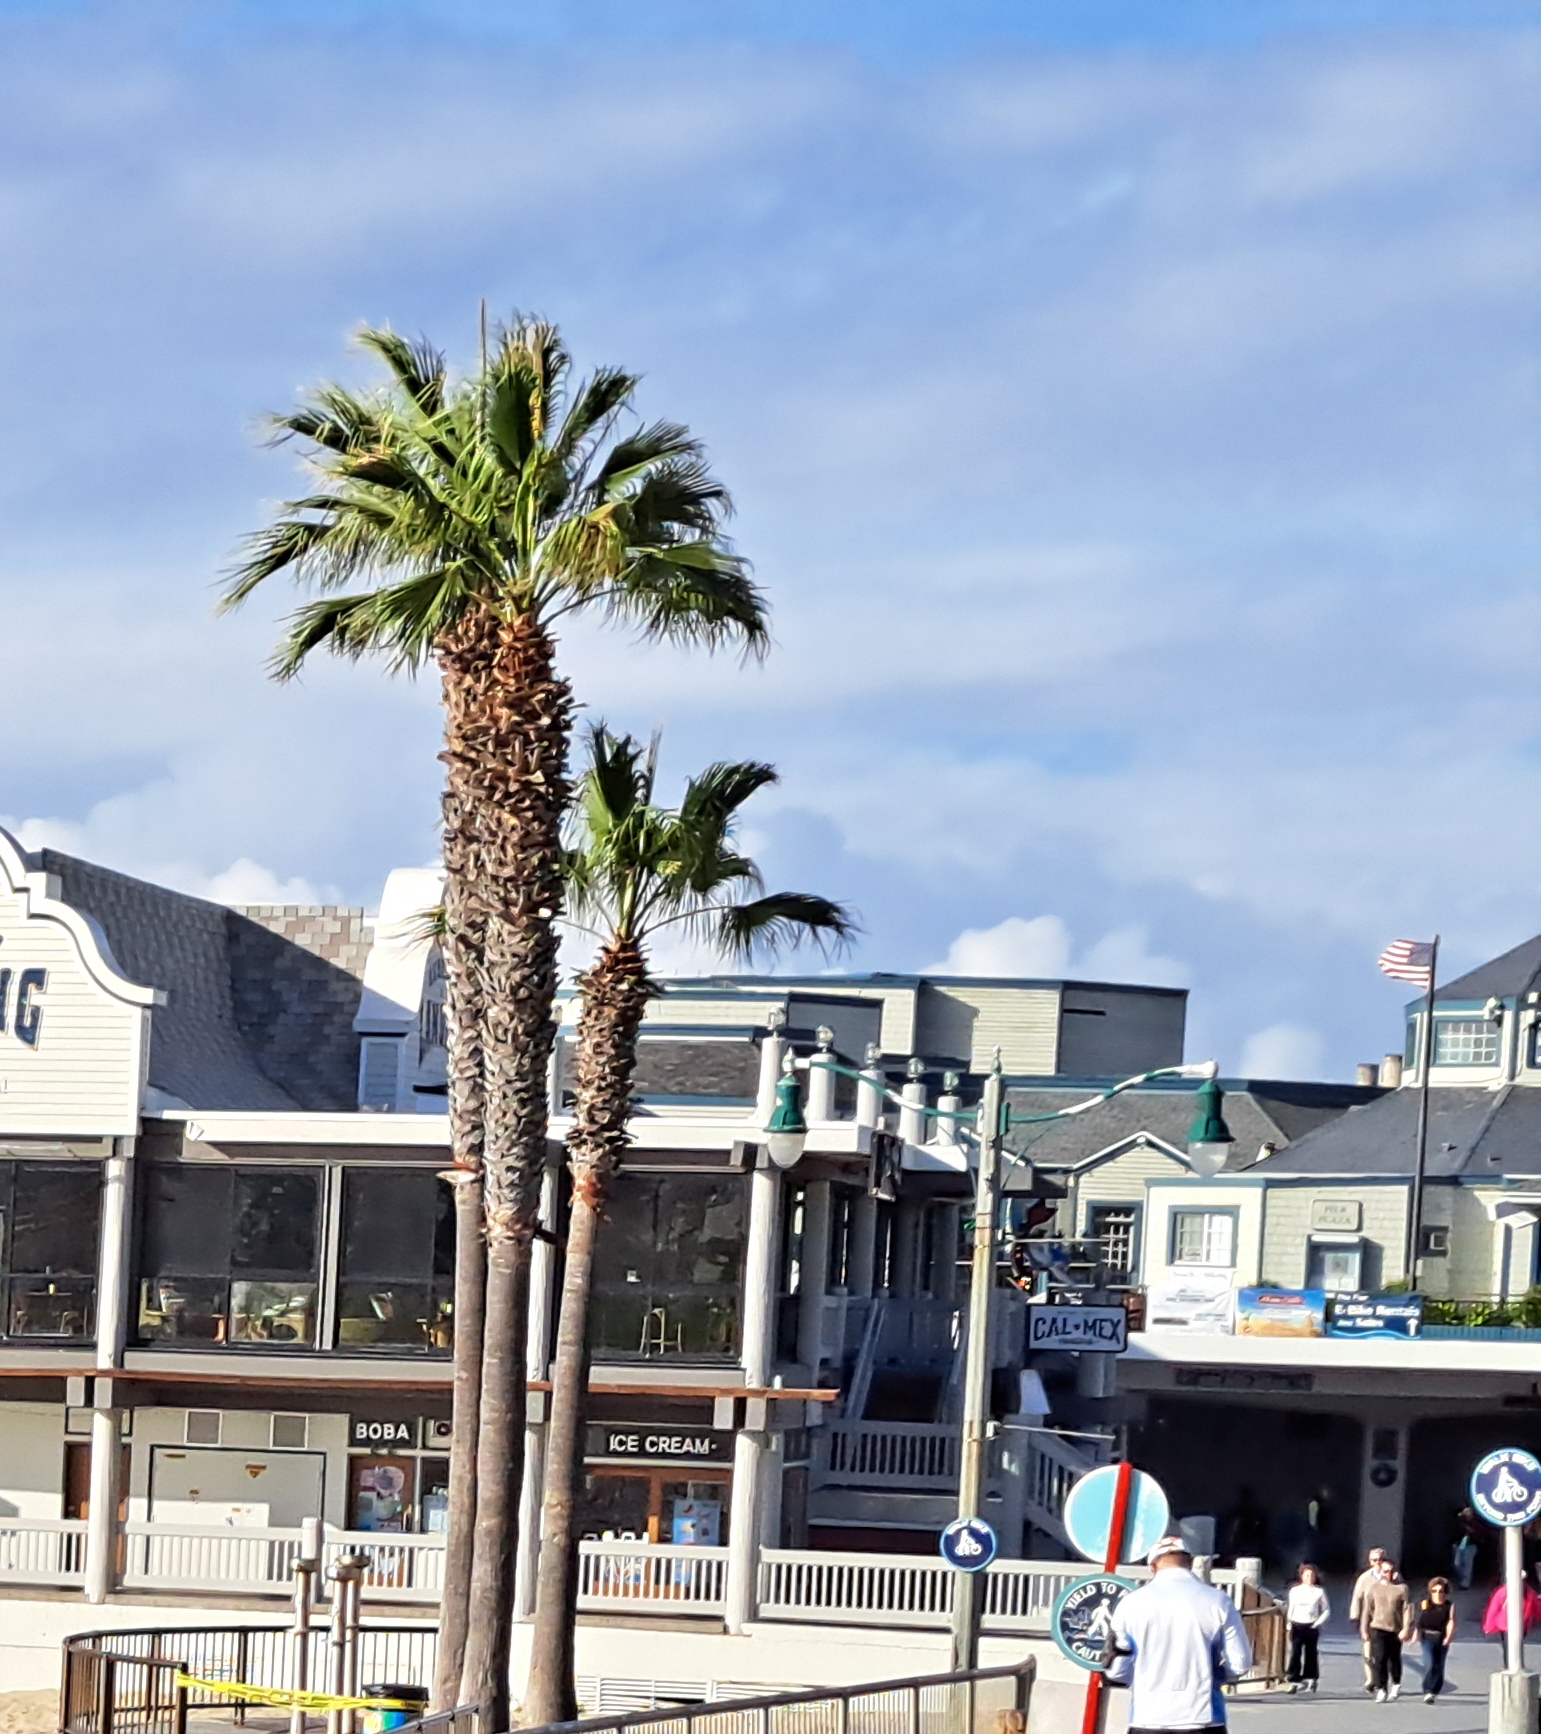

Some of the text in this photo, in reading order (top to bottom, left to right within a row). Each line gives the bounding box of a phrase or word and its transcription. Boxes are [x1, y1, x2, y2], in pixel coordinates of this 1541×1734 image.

[355, 1421, 410, 1440] BOBA
[608, 1433, 710, 1455] ICE CREAM
[1064, 1584, 1097, 1609] YIELD
[1100, 1582, 1117, 1595] TO
[1071, 1641, 1103, 1661] CAUT
